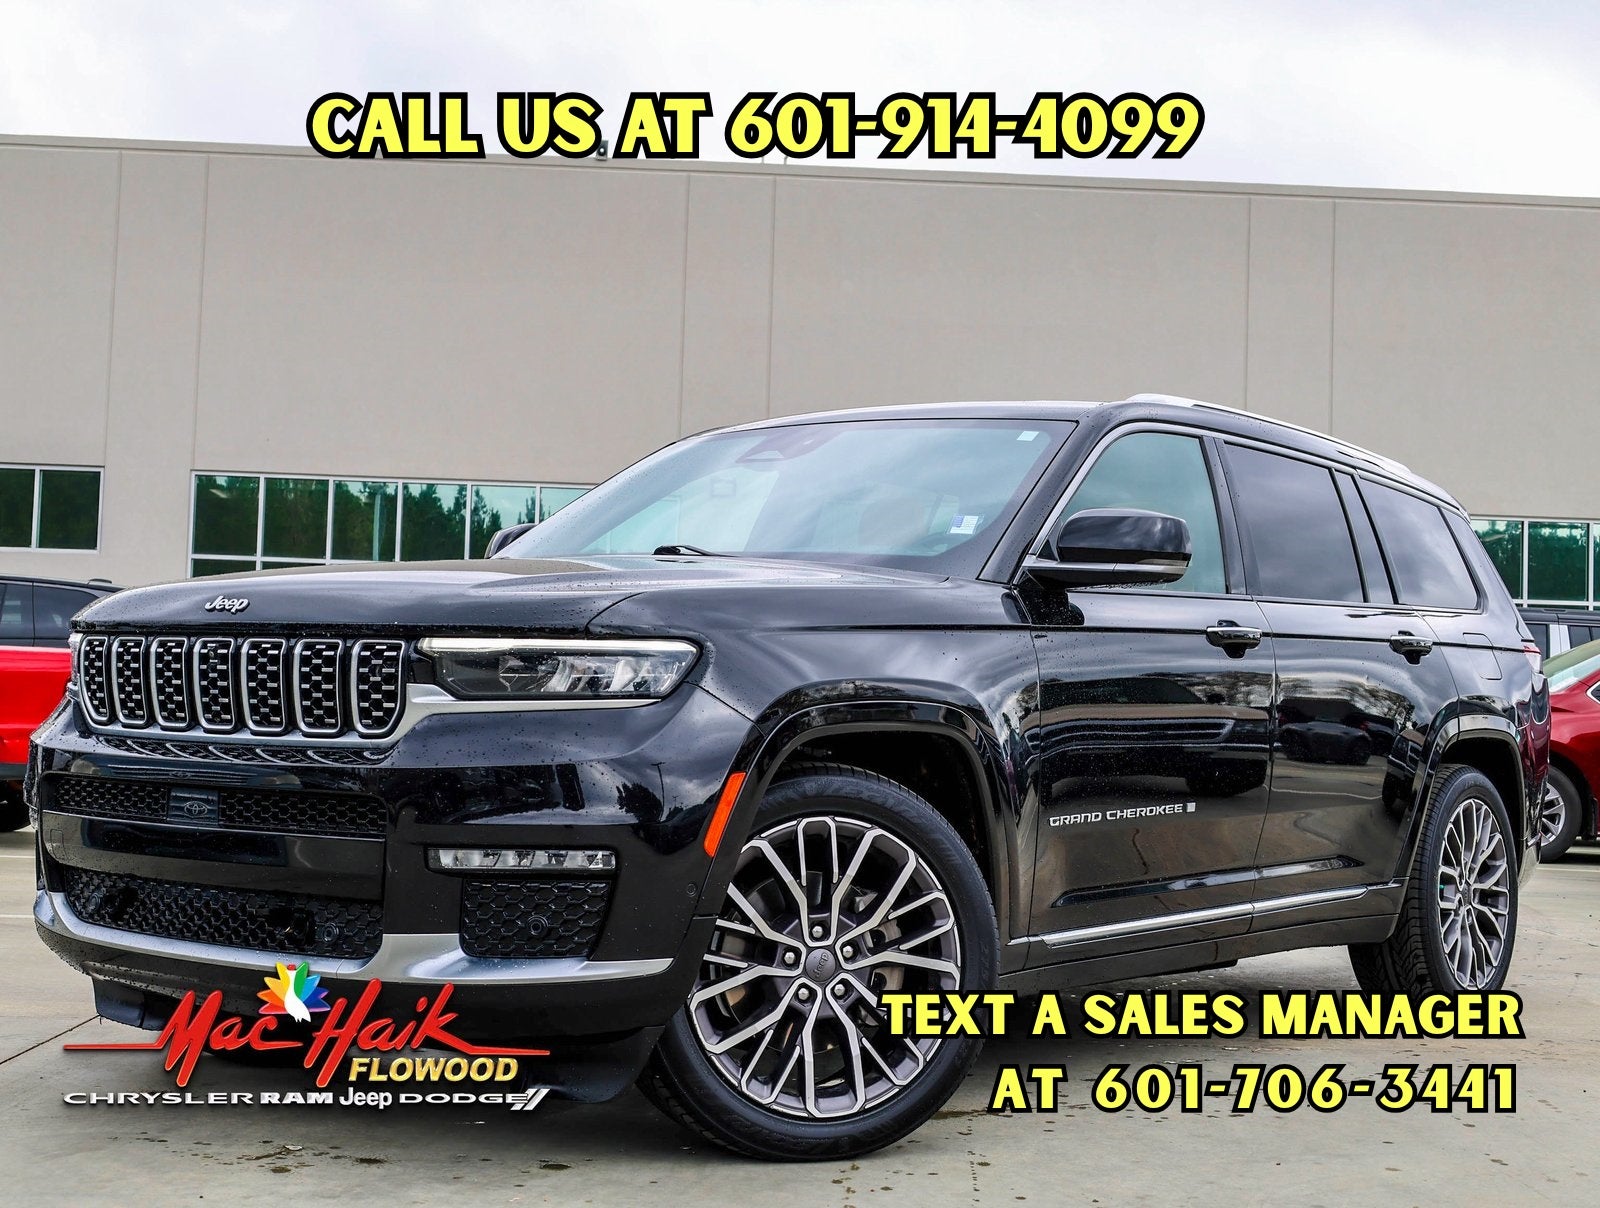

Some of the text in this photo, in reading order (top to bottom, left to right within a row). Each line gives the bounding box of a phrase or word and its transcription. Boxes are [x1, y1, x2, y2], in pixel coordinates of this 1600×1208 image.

[204, 595, 250, 614] Jeep
[1049, 803, 1183, 827] GRAND CHEROKEE
